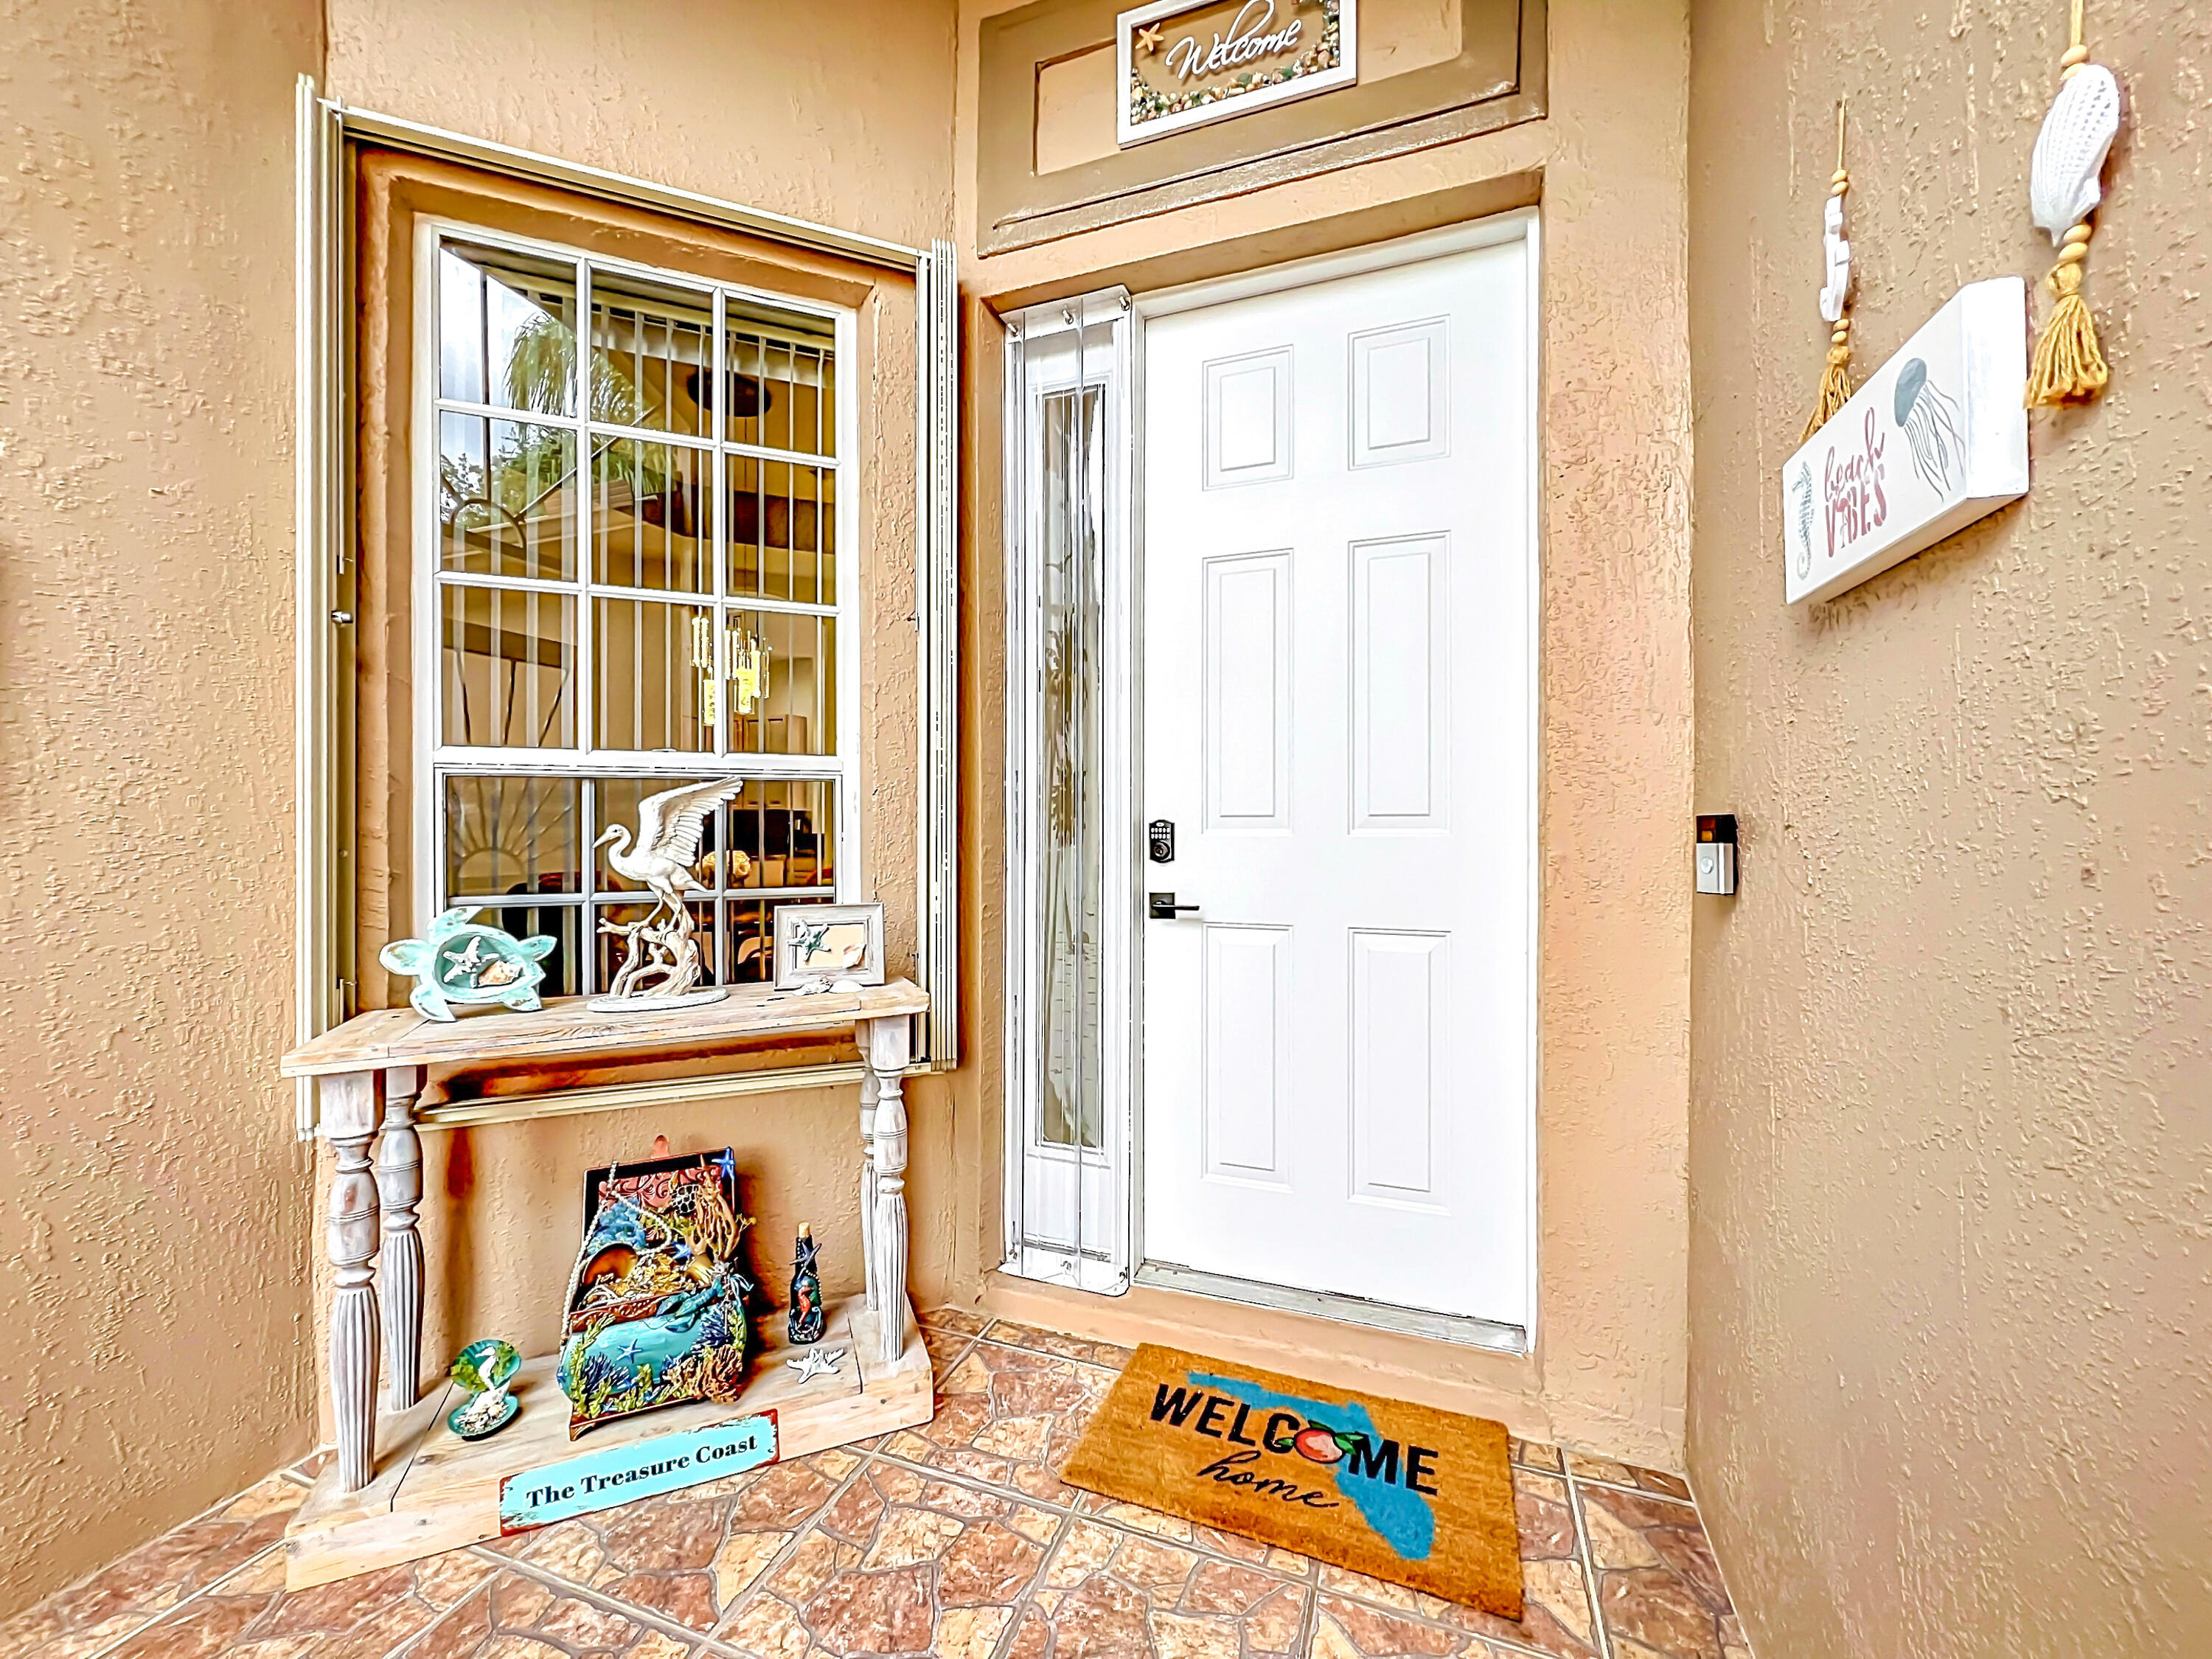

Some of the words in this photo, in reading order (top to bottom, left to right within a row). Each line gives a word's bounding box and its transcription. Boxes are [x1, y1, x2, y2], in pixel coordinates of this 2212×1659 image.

[1166, 0, 1302, 80] Welcome
[1825, 407, 1885, 504] beach
[1825, 463, 1888, 558] VIBES
[526, 1485, 575, 1509] The
[580, 1456, 690, 1495] Treasure
[695, 1435, 758, 1464] Coast
[1149, 1382, 1439, 1496] WELCOME
[1197, 1450, 1340, 1509] home
